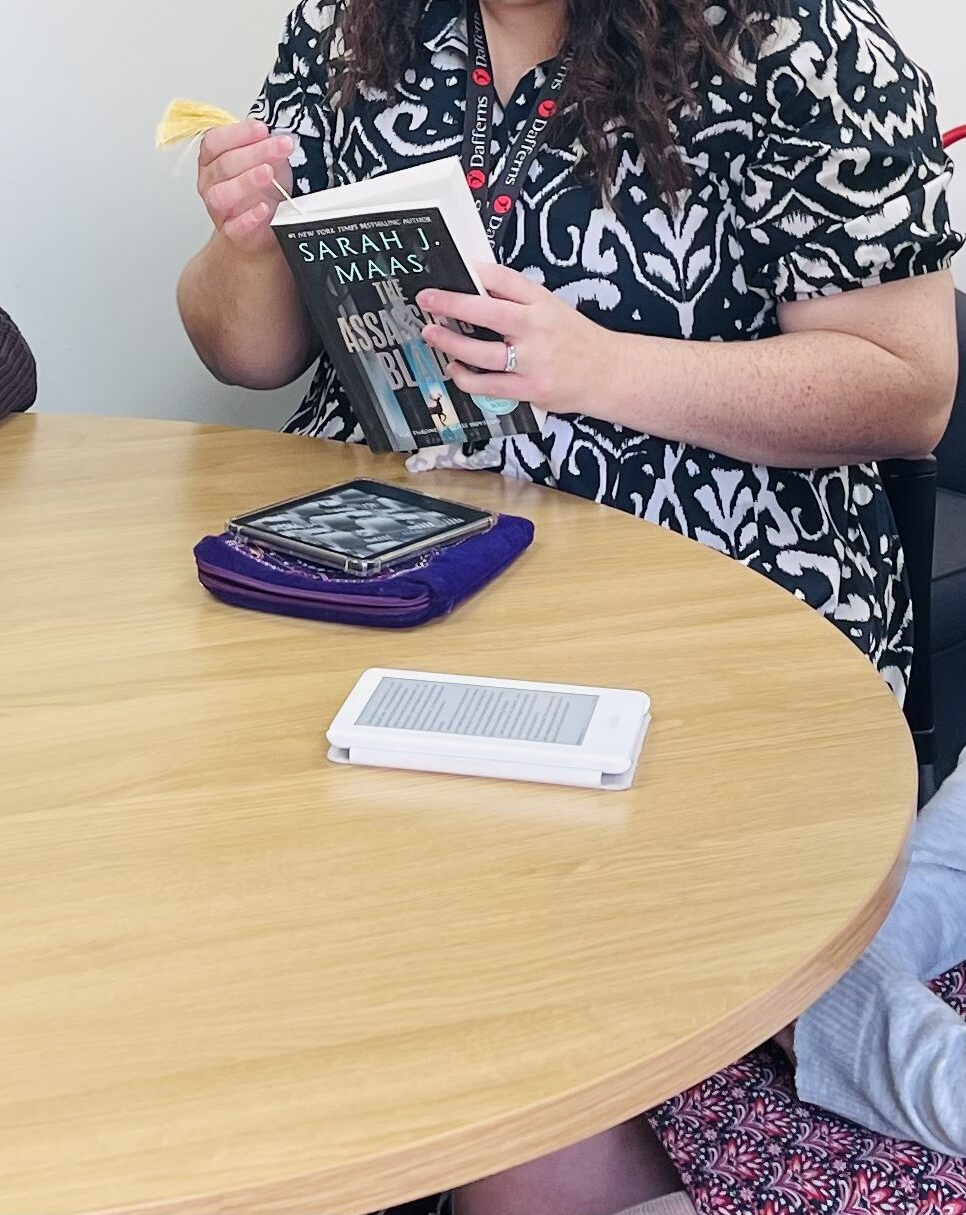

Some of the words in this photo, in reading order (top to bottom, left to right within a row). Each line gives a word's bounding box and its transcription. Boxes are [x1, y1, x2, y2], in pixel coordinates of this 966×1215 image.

[470, 95, 488, 168] Dafferns
[505, 118, 548, 186] Dafferns
[298, 230, 315, 239] NEW
[316, 228, 336, 236] YORK
[337, 223, 359, 233] TIMES
[402, 216, 433, 225] AUTHOR
[298, 230, 404, 263] SARAH
[416, 227, 441, 252] J.
[334, 253, 424, 285] MAAS
[371, 278, 409, 306] THE
